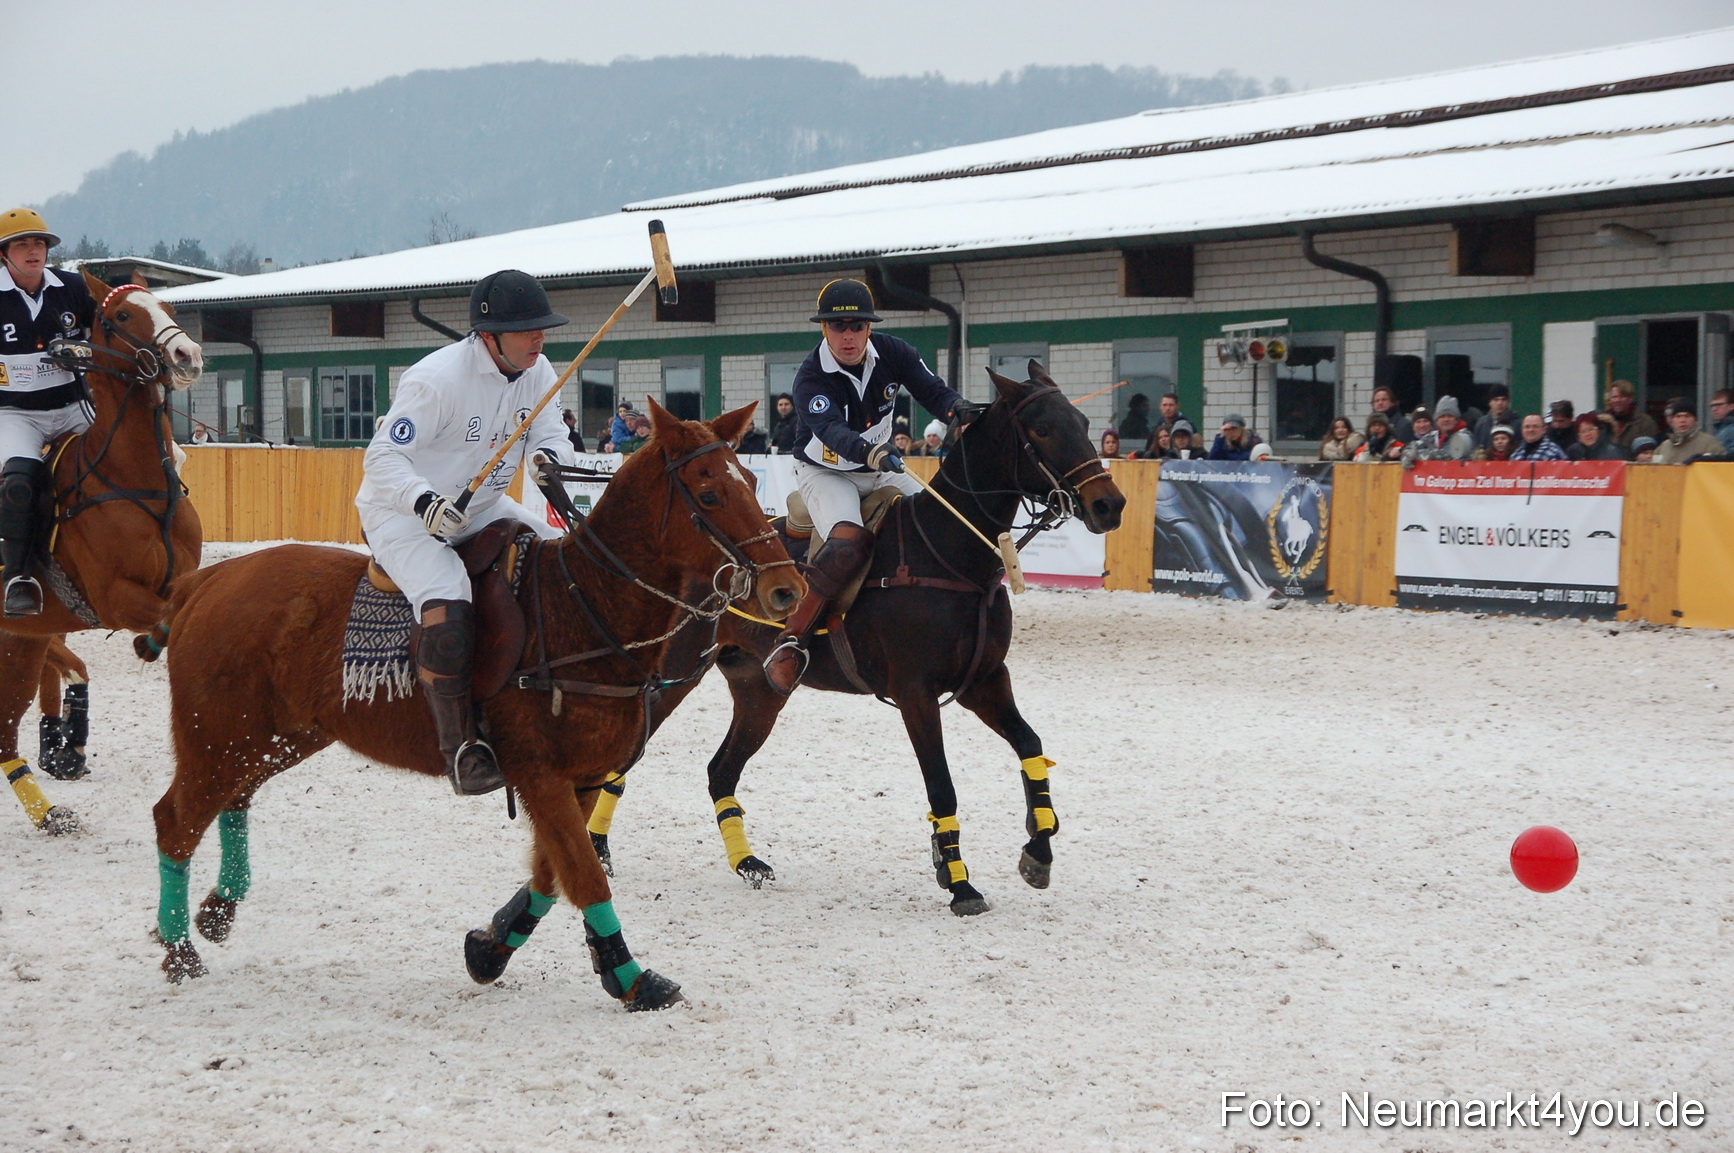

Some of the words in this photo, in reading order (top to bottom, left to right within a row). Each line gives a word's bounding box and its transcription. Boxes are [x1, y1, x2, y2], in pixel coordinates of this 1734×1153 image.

[3, 323, 18, 342] 2
[843, 404, 849, 422] 1
[465, 416, 481, 442] 2
[1426, 475, 1456, 490] Galopp
[1457, 478, 1476, 488] zum
[1476, 475, 1494, 488] Ziel
